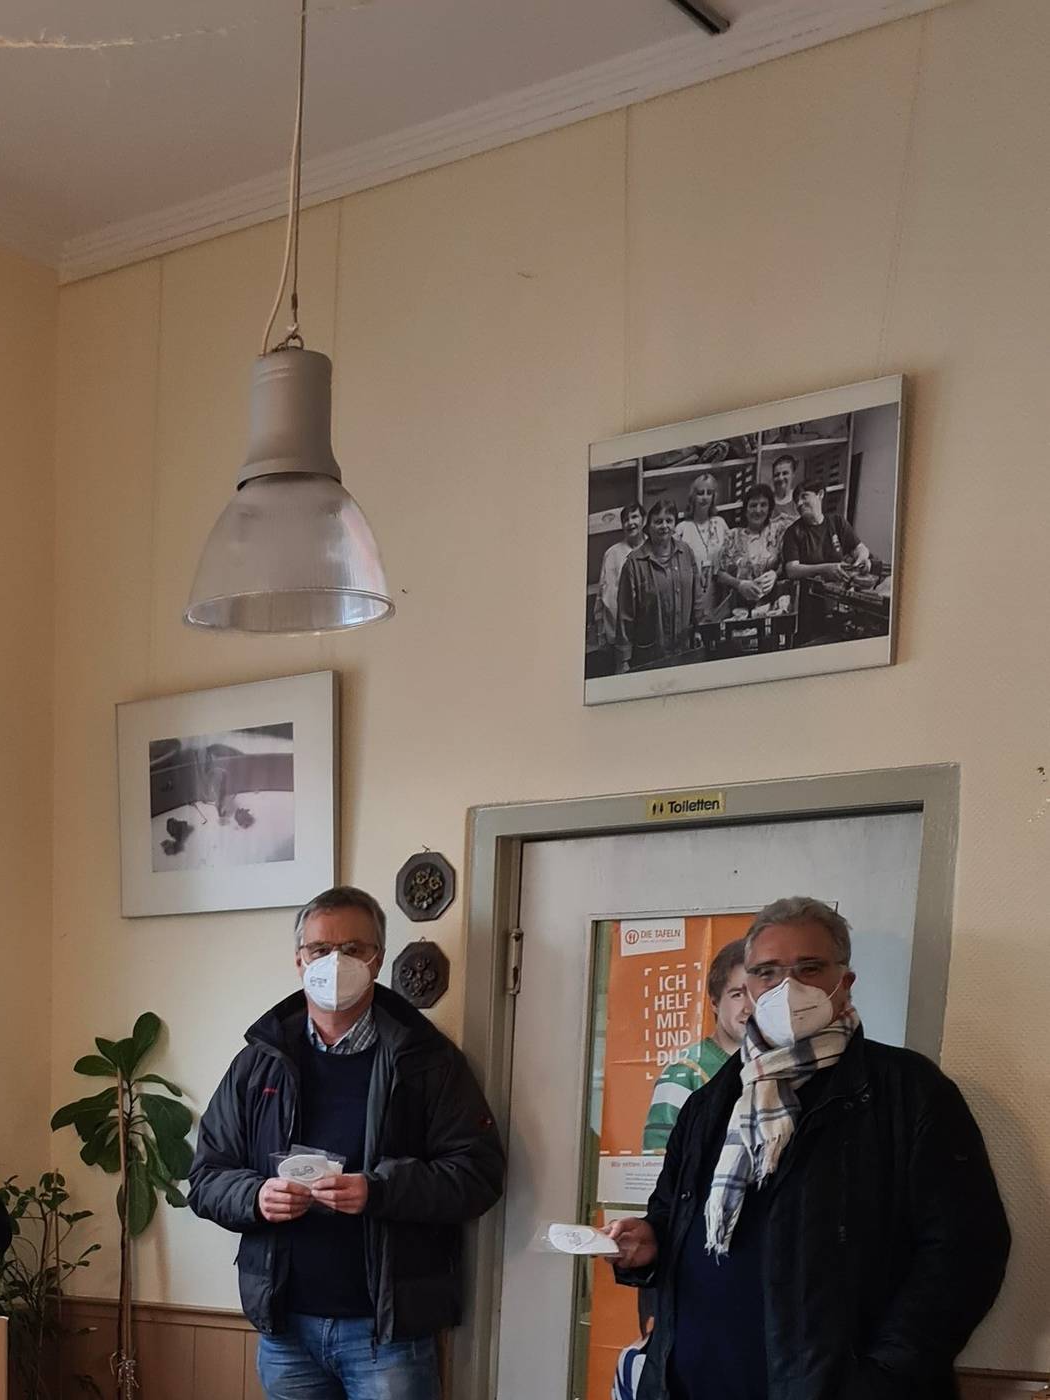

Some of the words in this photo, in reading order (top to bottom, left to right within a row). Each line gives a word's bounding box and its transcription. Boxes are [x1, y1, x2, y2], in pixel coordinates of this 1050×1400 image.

[667, 798, 720, 814] Toiletten
[640, 929, 652, 938] DIE
[655, 928, 681, 938] TAFELN
[659, 974, 687, 992] ICH
[654, 992, 693, 1011] HELF
[657, 1011, 690, 1029] MIT.
[655, 1029, 691, 1048] UND
[657, 1048, 690, 1067] DU?
